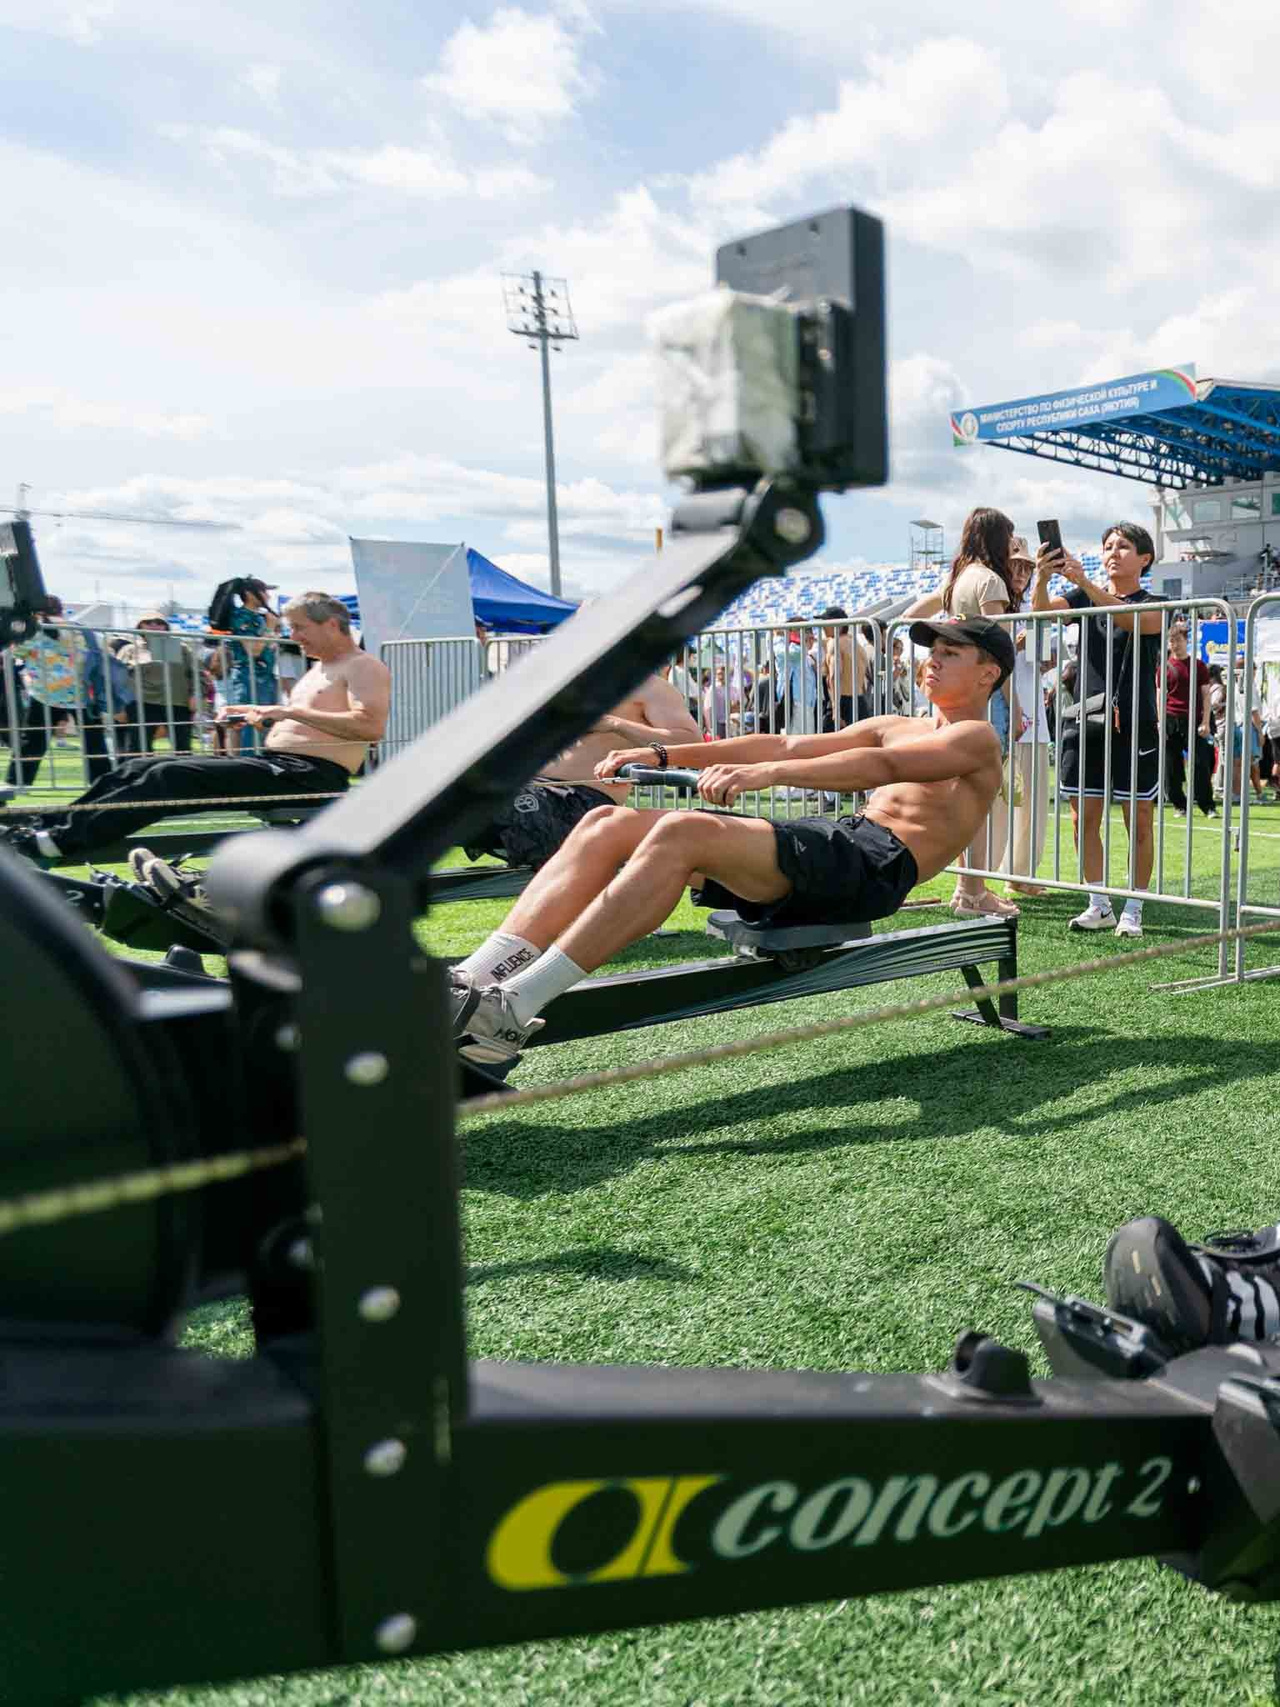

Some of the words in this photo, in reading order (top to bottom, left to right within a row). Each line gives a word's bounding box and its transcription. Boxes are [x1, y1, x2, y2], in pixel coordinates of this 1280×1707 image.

[490, 948, 535, 981] INFLUENCE
[711, 1461, 1121, 1558] concept
[1127, 1456, 1173, 1517] 2
